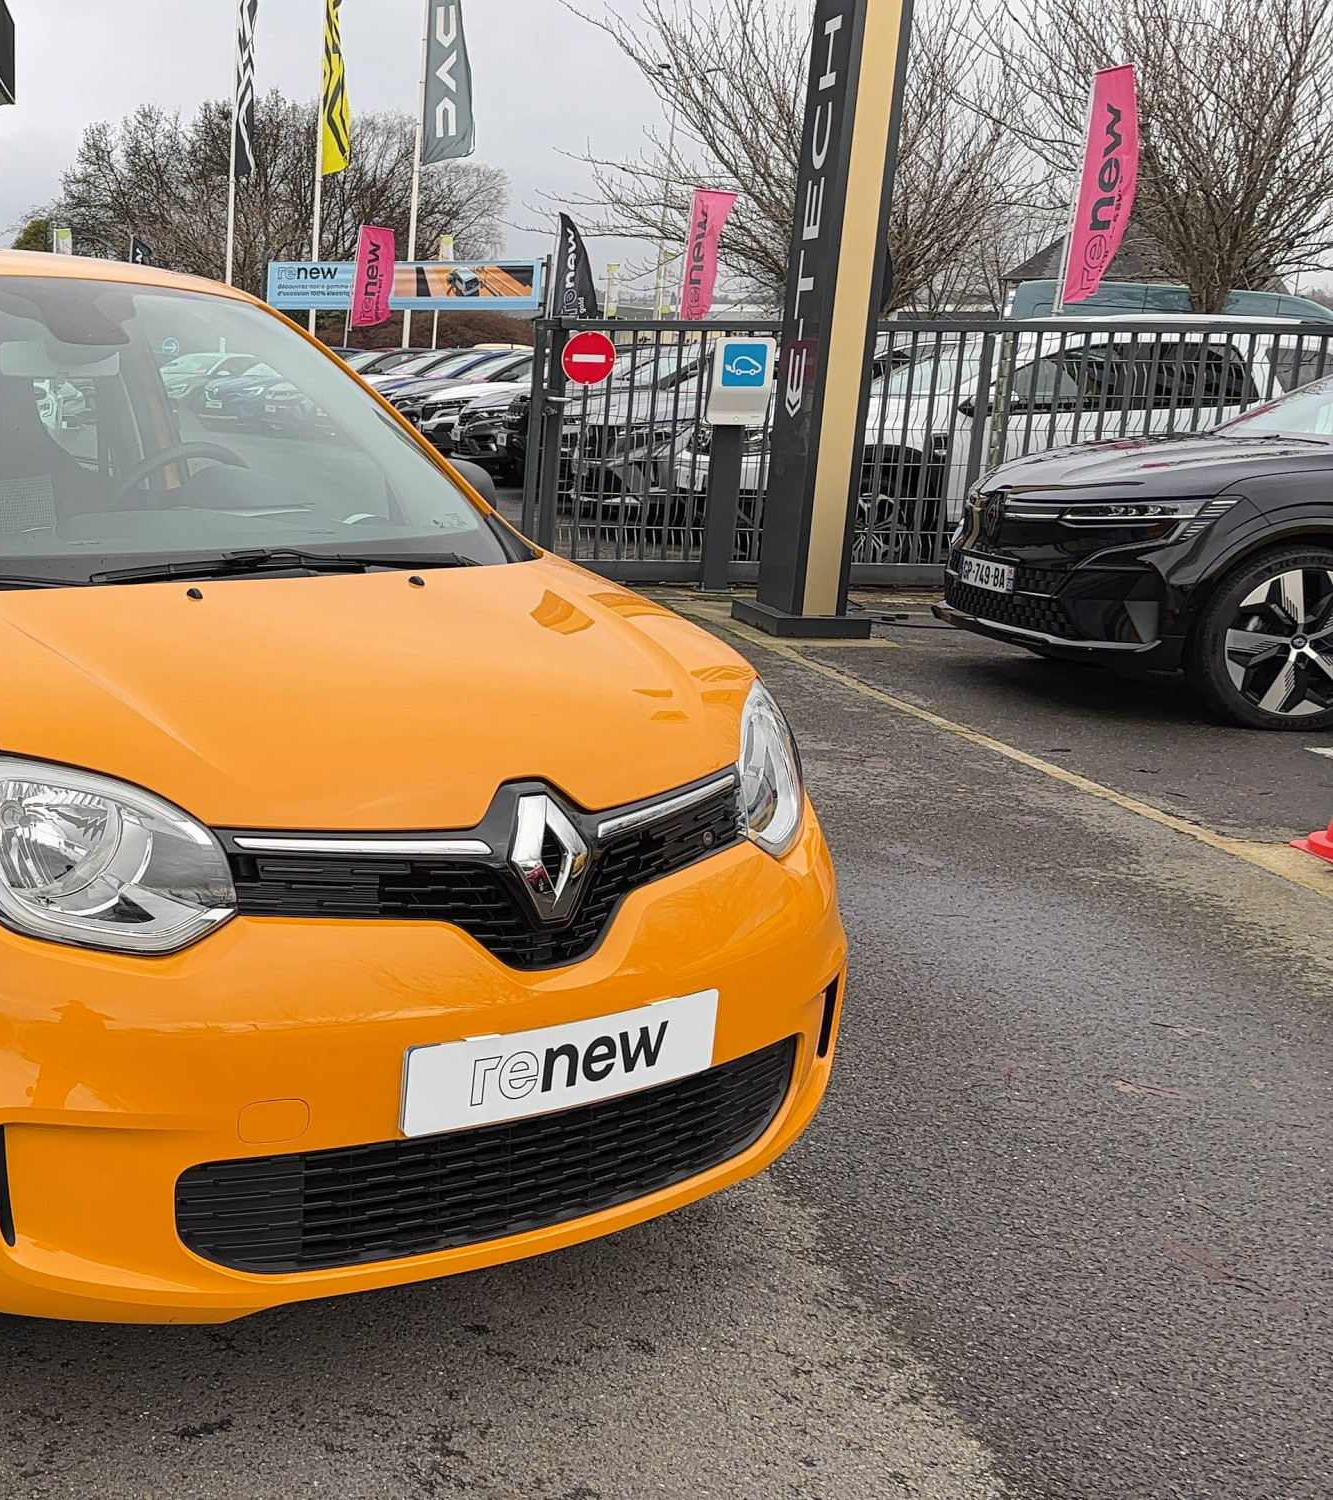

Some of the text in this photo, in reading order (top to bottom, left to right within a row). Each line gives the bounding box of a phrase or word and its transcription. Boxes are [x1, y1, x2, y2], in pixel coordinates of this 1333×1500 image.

[784, 14, 843, 418] E-TECH
[1079, 102, 1122, 291] renew
[277, 266, 338, 280] renew
[360, 241, 381, 322] renew
[562, 227, 578, 315] renew
[577, 296, 586, 314] gold
[470, 1019, 669, 1107] renew
